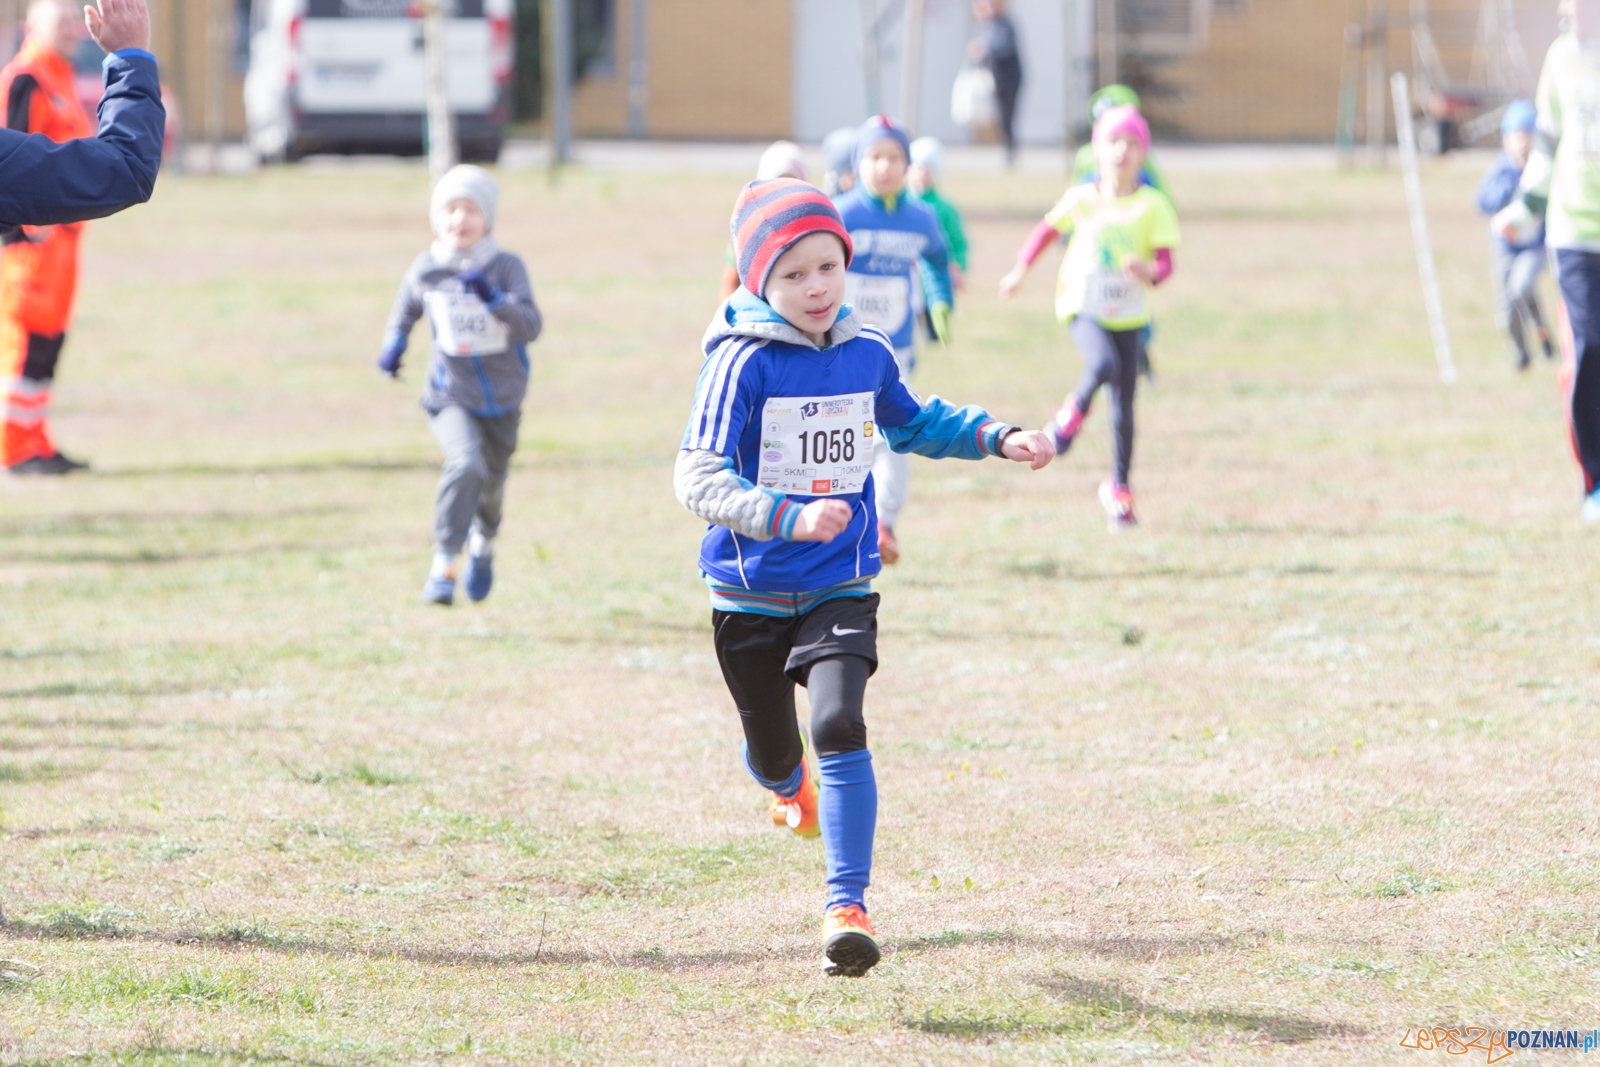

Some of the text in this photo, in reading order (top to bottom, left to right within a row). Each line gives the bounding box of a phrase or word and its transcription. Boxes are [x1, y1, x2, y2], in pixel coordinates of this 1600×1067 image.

[798, 428, 854, 464] 1058
[784, 468, 805, 476] 5KM
[842, 466, 862, 475] 10KM
